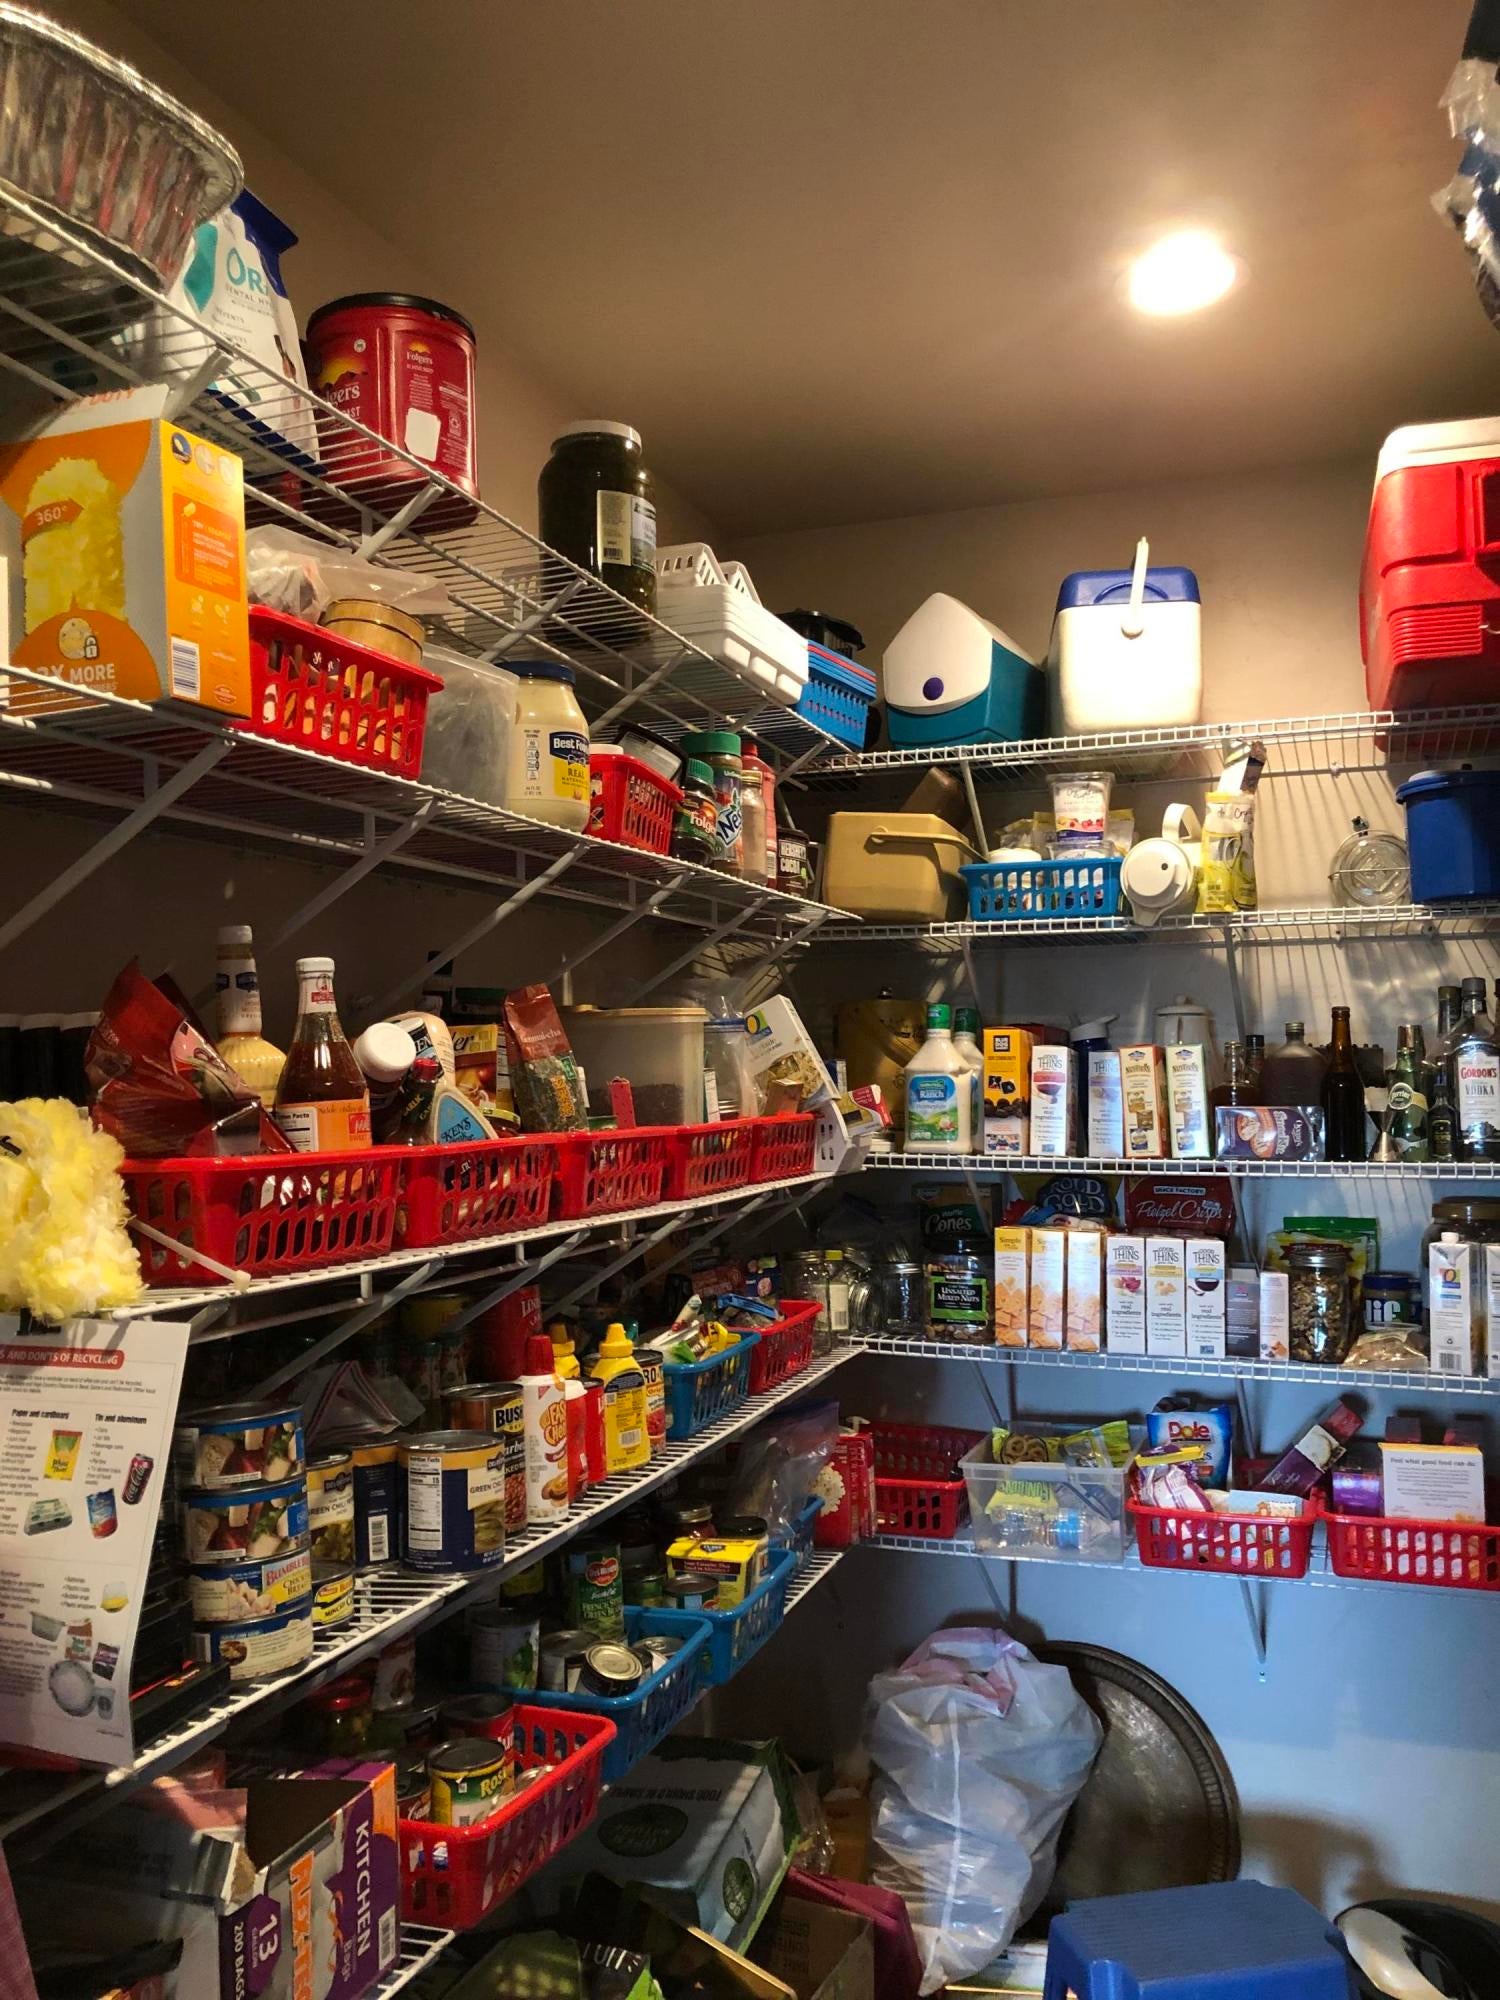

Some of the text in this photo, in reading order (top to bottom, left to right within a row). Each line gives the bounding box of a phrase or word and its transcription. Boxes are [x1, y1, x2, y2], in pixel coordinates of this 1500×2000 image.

[69, 664, 115, 683] MORE
[553, 738, 575, 749] Best
[689, 811, 716, 834] Folge
[1038, 1057, 1062, 1068] THINS
[1465, 1082, 1495, 1095] VODKA
[1136, 1200, 1177, 1224] Pretzel
[925, 1214, 972, 1234] Cones
[1113, 1247, 1140, 1260] THINS
[1153, 1249, 1179, 1262] THINS
[1193, 1251, 1220, 1264] THINS
[7, 1352, 28, 1360] AND
[59, 1353, 70, 1362] OF
[72, 1353, 119, 1365] RECYCLING
[11, 1408, 28, 1417] Paper
[41, 1410, 70, 1419] cardboard
[95, 1413, 147, 1424] Tin and aluminum
[1168, 1421, 1210, 1438] Dole
[470, 1484, 492, 1493] GREEN
[356, 1820, 371, 1957] KITCHEN
[259, 1914, 278, 1961] 13
[234, 1922, 246, 2000] 200 BAGS
